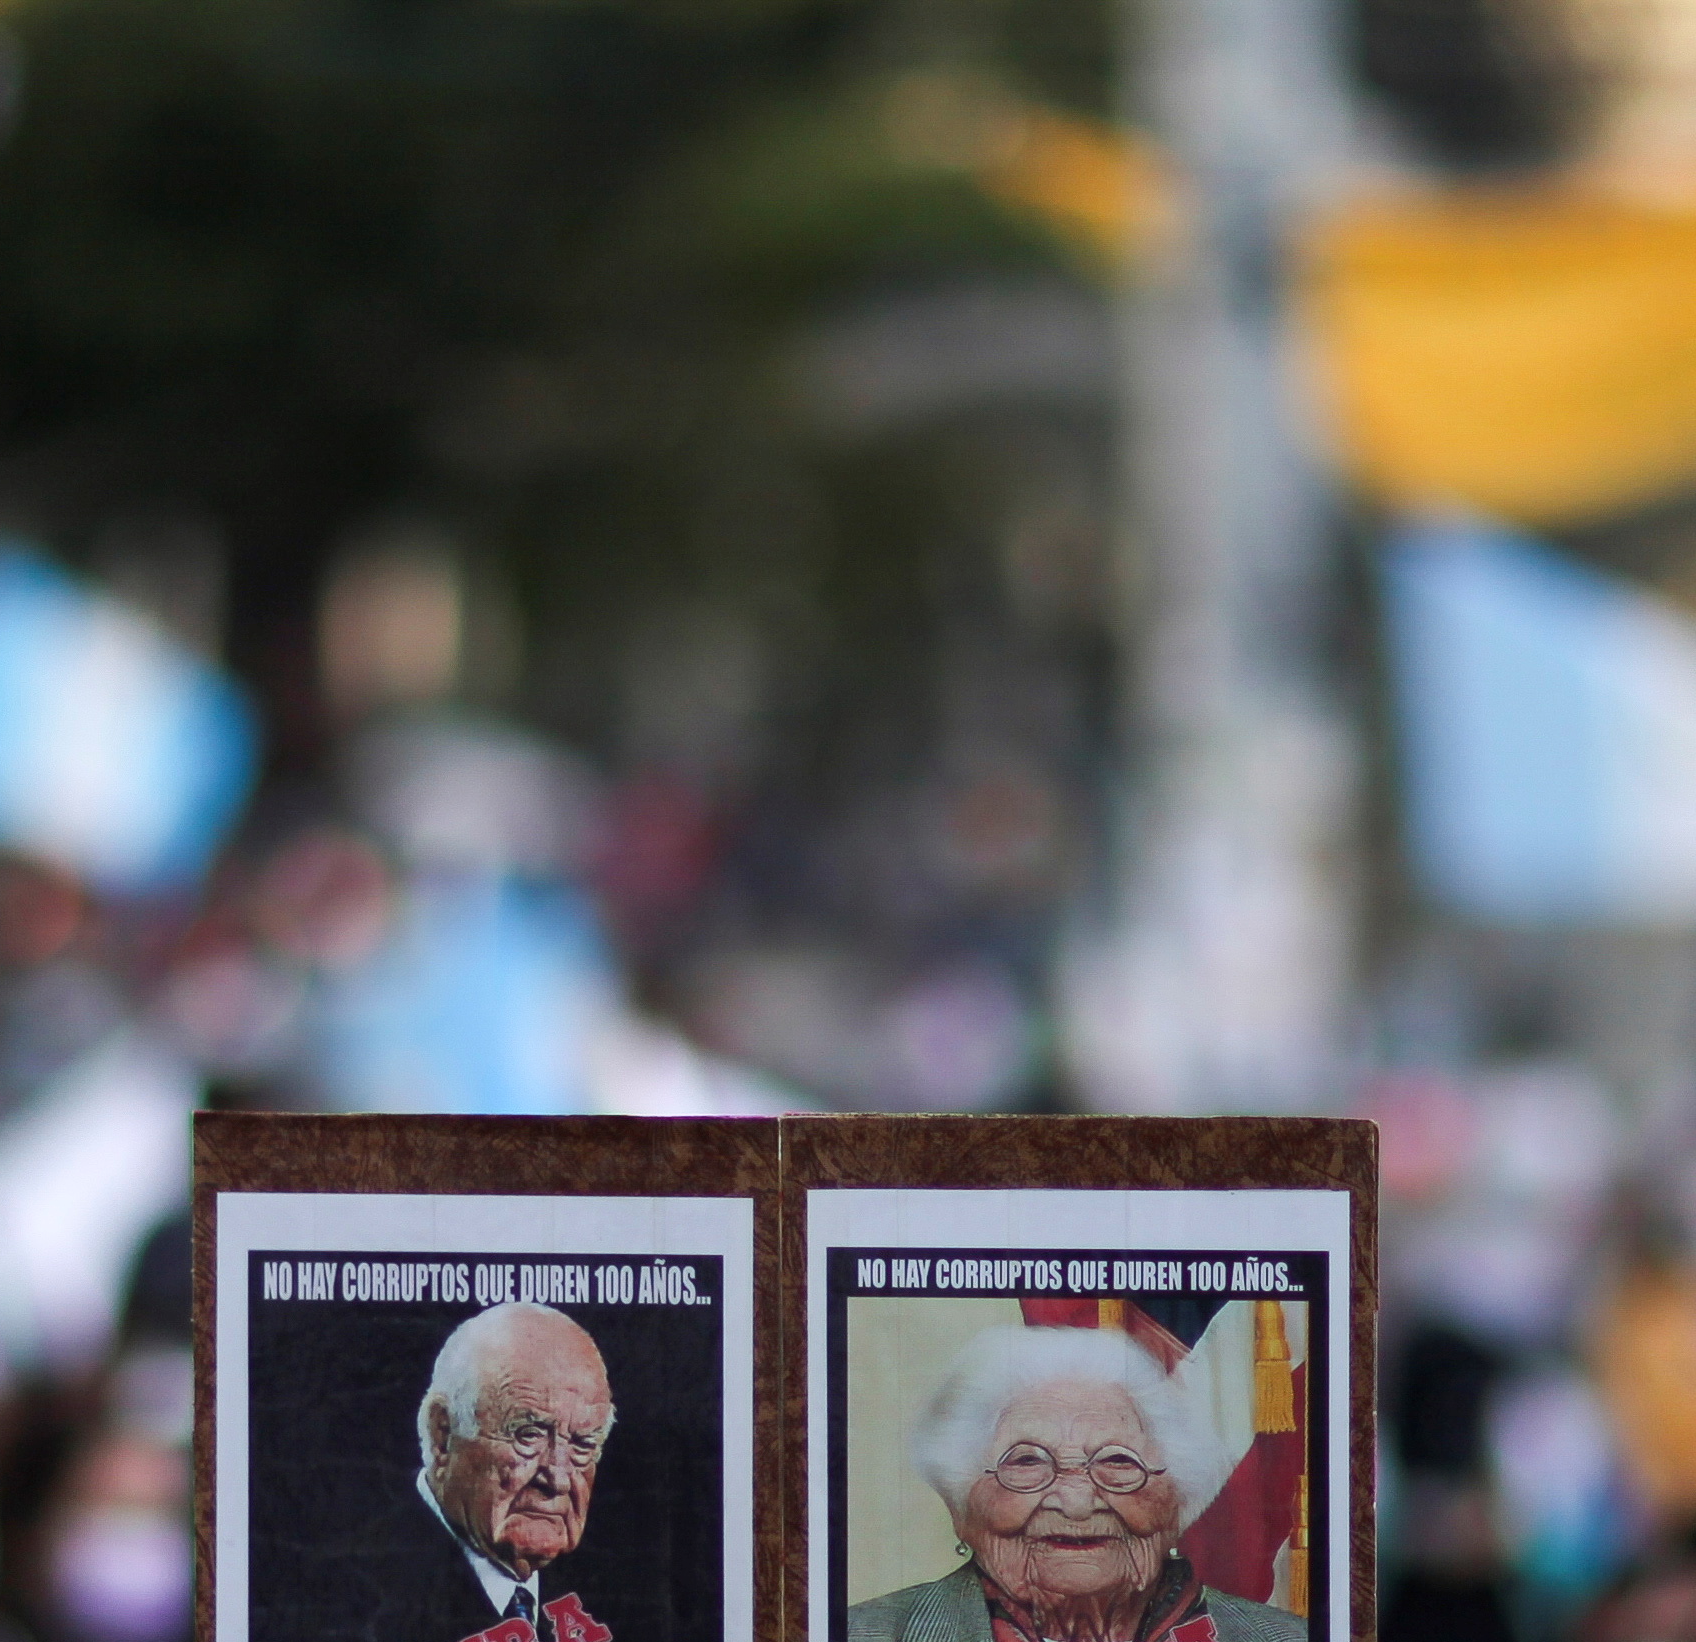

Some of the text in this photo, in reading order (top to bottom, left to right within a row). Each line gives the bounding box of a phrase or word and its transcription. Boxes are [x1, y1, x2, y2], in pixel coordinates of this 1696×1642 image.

[264, 1258, 711, 1306] NO HAY CORRUPTOS QUE DUREN 100 AÑOS...
[857, 1256, 1304, 1293] NO HAY CORRUPTOS QUE DUREN 100 AÑOS...
